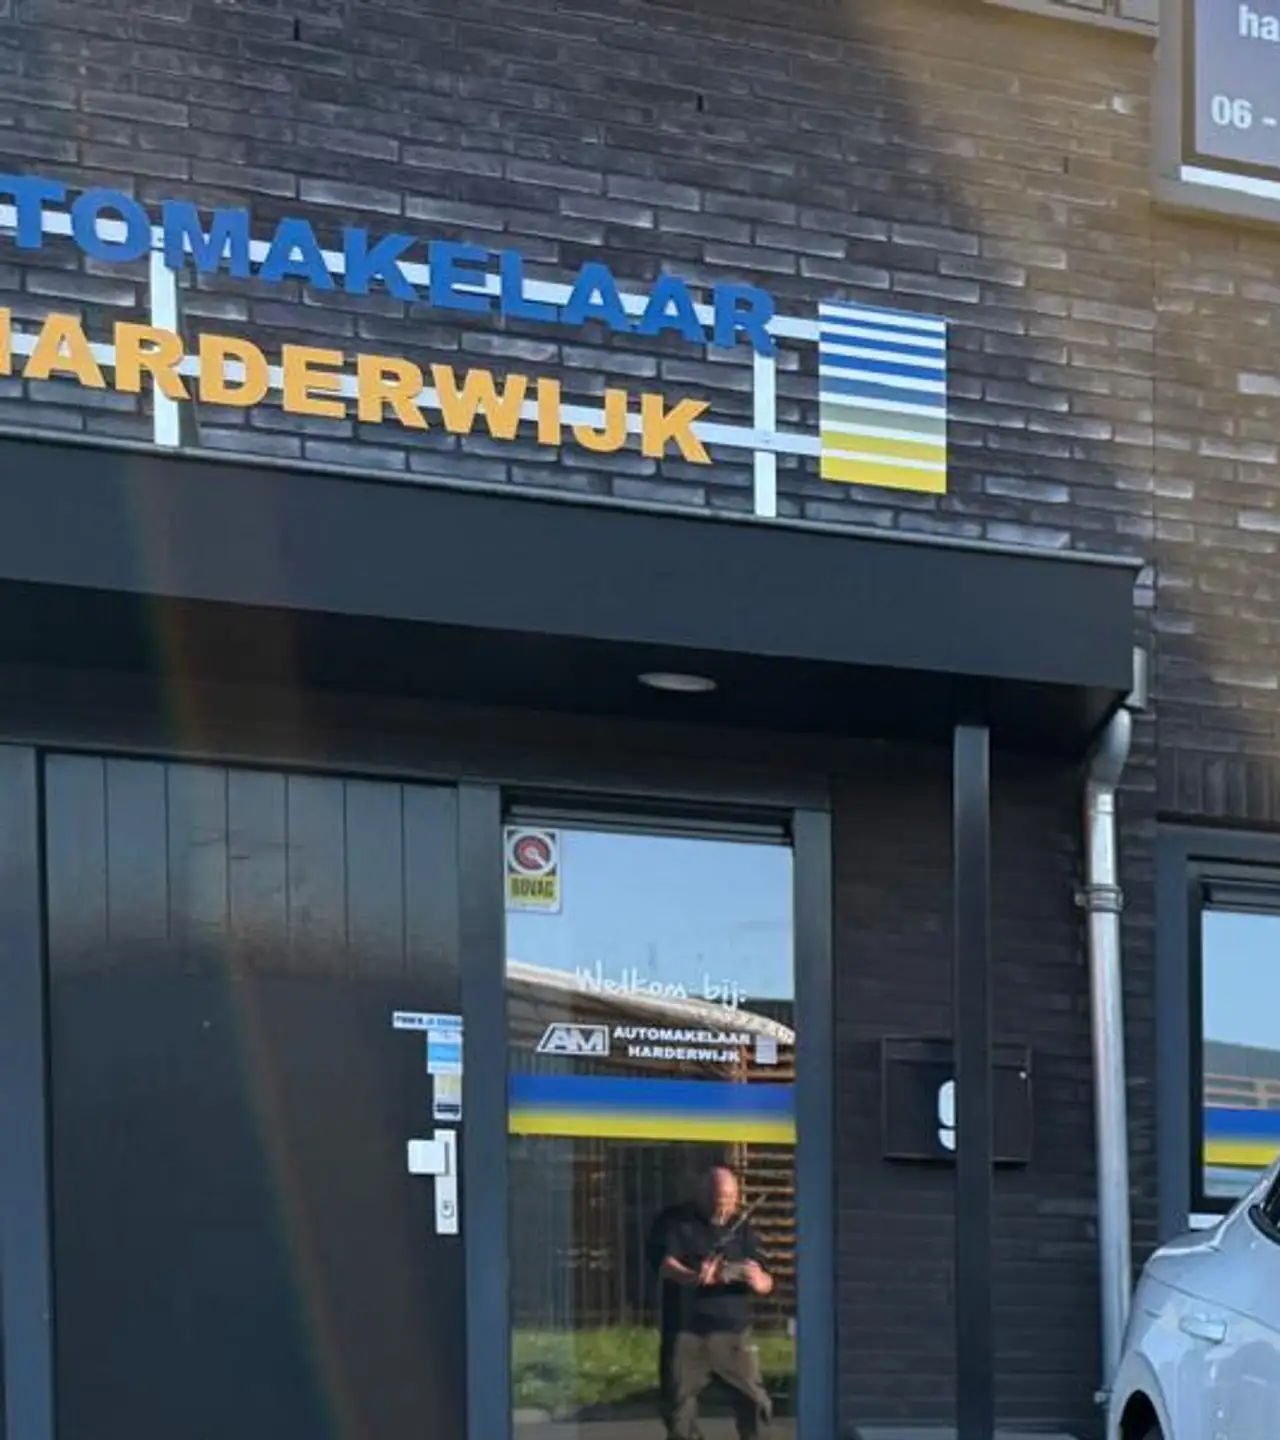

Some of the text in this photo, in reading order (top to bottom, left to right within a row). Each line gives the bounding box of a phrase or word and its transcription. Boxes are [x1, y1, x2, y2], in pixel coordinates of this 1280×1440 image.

[1210, 95, 1253, 129] 06
[0, 306, 714, 466] ARDERWIJK
[576, 960, 689, 999] Welkom
[613, 1025, 751, 1045] AUTOMAKELAAR
[628, 1045, 741, 1063] HARDERWIJK
